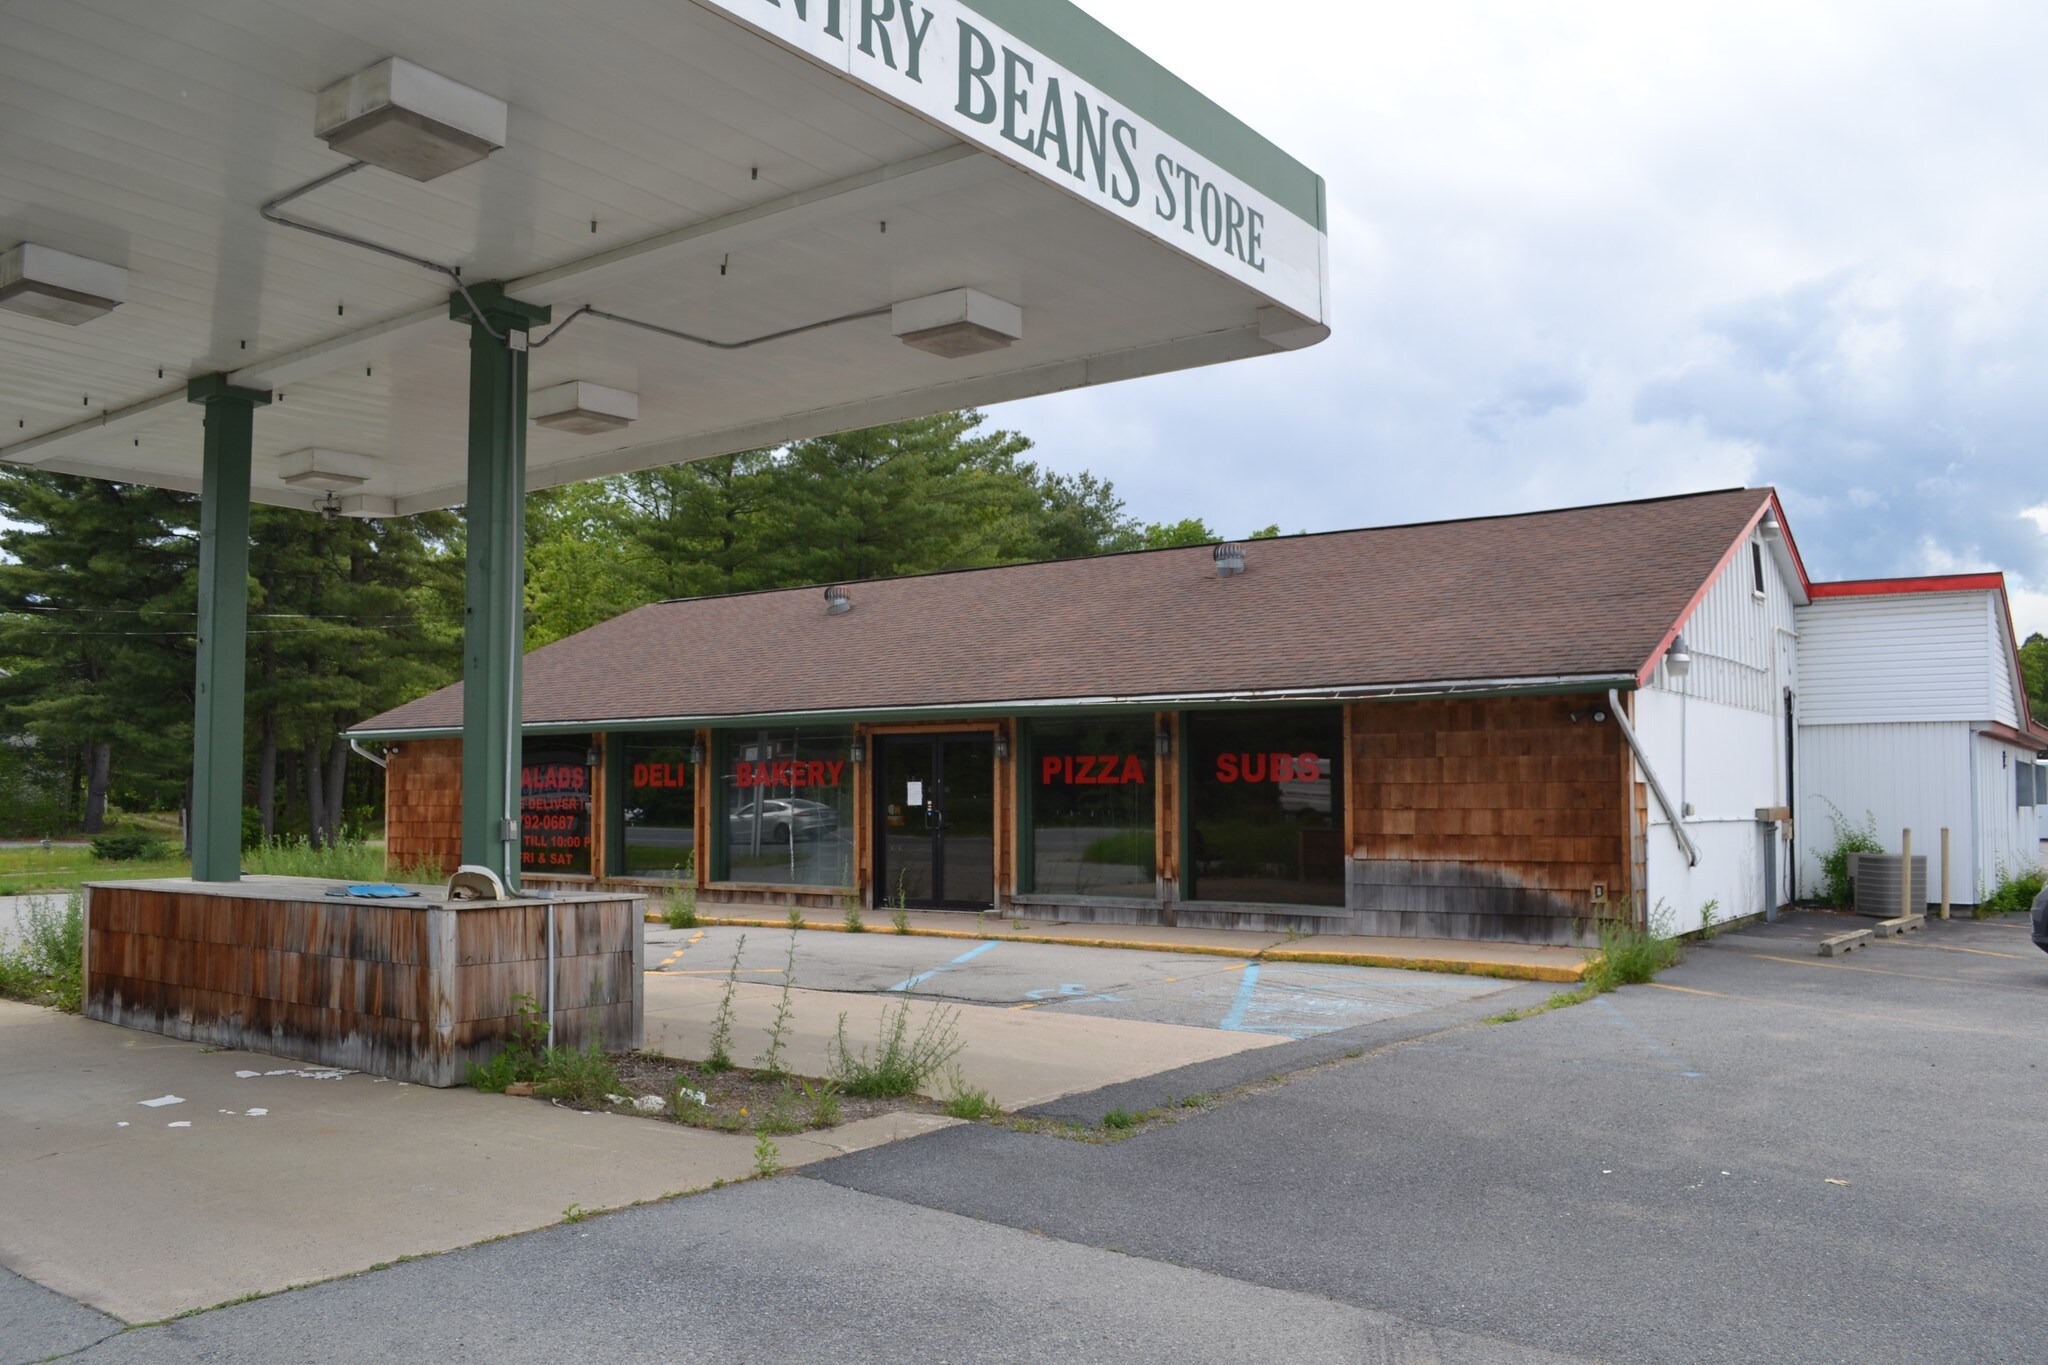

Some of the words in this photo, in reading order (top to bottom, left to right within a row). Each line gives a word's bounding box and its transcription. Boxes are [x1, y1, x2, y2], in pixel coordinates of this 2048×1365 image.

[954, 17, 1140, 208] BEANS
[1155, 153, 1265, 273] STORE
[521, 767, 584, 788] ALADS
[633, 763, 684, 787] DELI
[736, 760, 844, 787] BAKERY
[1042, 755, 1145, 784] PIZZA
[1216, 752, 1321, 783] SUBS
[529, 798, 576, 810] DELIVER
[524, 835, 547, 847] TILL
[551, 836, 580, 848] 10:00
[584, 836, 591, 848] P
[538, 853, 546, 864] &
[550, 853, 573, 865] SAT
